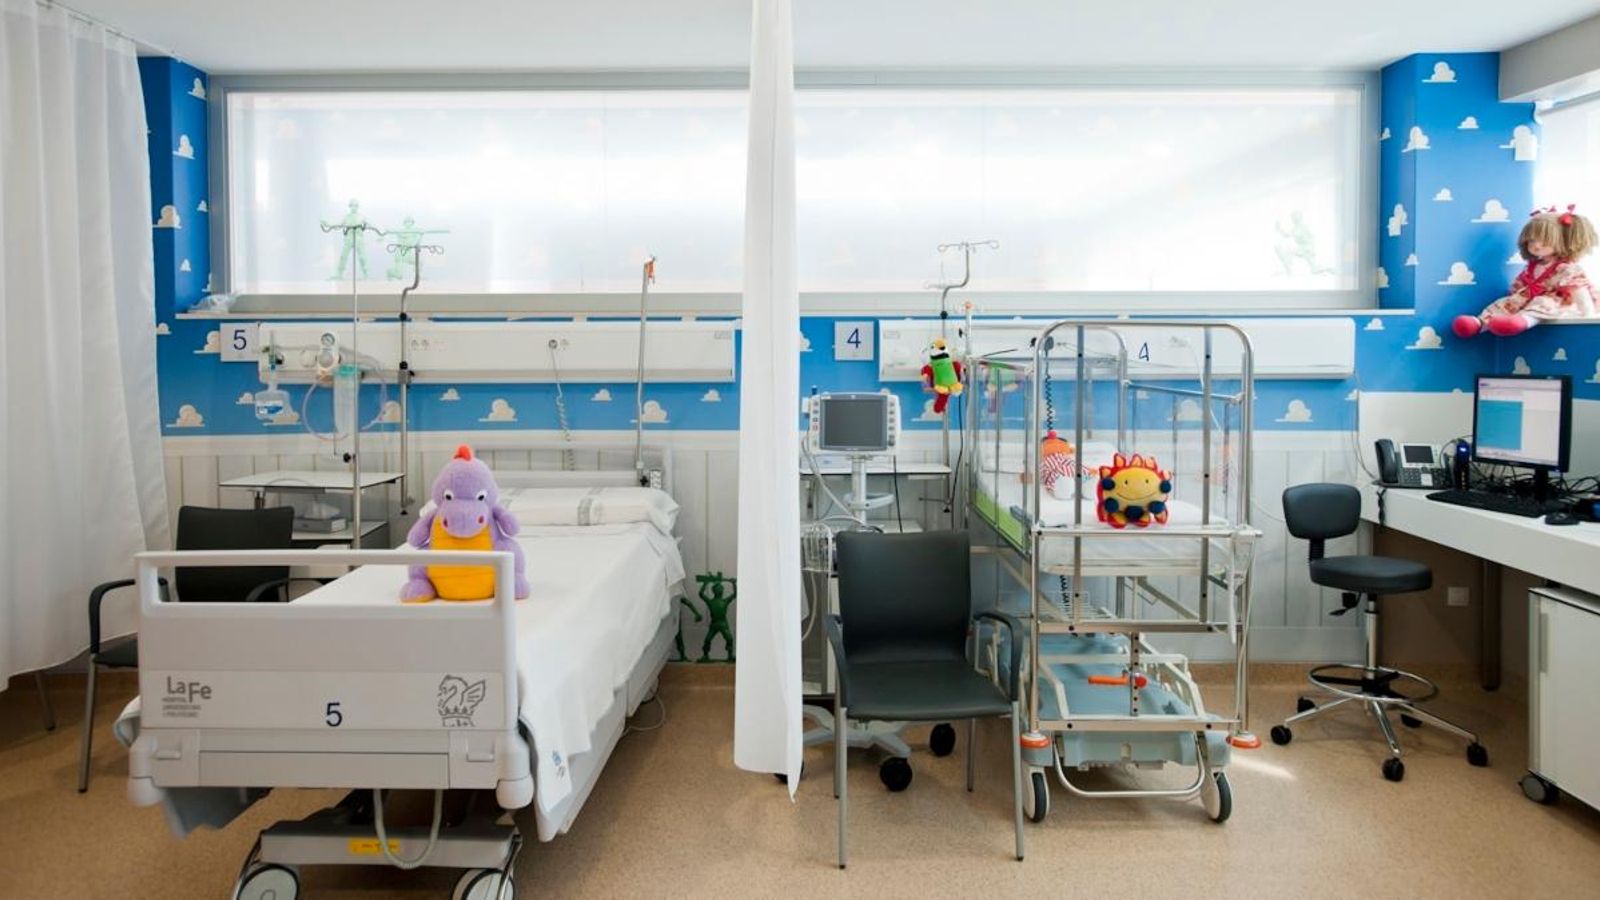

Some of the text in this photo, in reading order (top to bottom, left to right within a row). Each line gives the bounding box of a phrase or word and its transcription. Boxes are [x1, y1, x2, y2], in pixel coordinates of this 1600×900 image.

[233, 329, 247, 350] 5
[847, 328, 861, 348] 4
[1138, 342, 1150, 361] 4
[326, 702, 342, 727] 5
